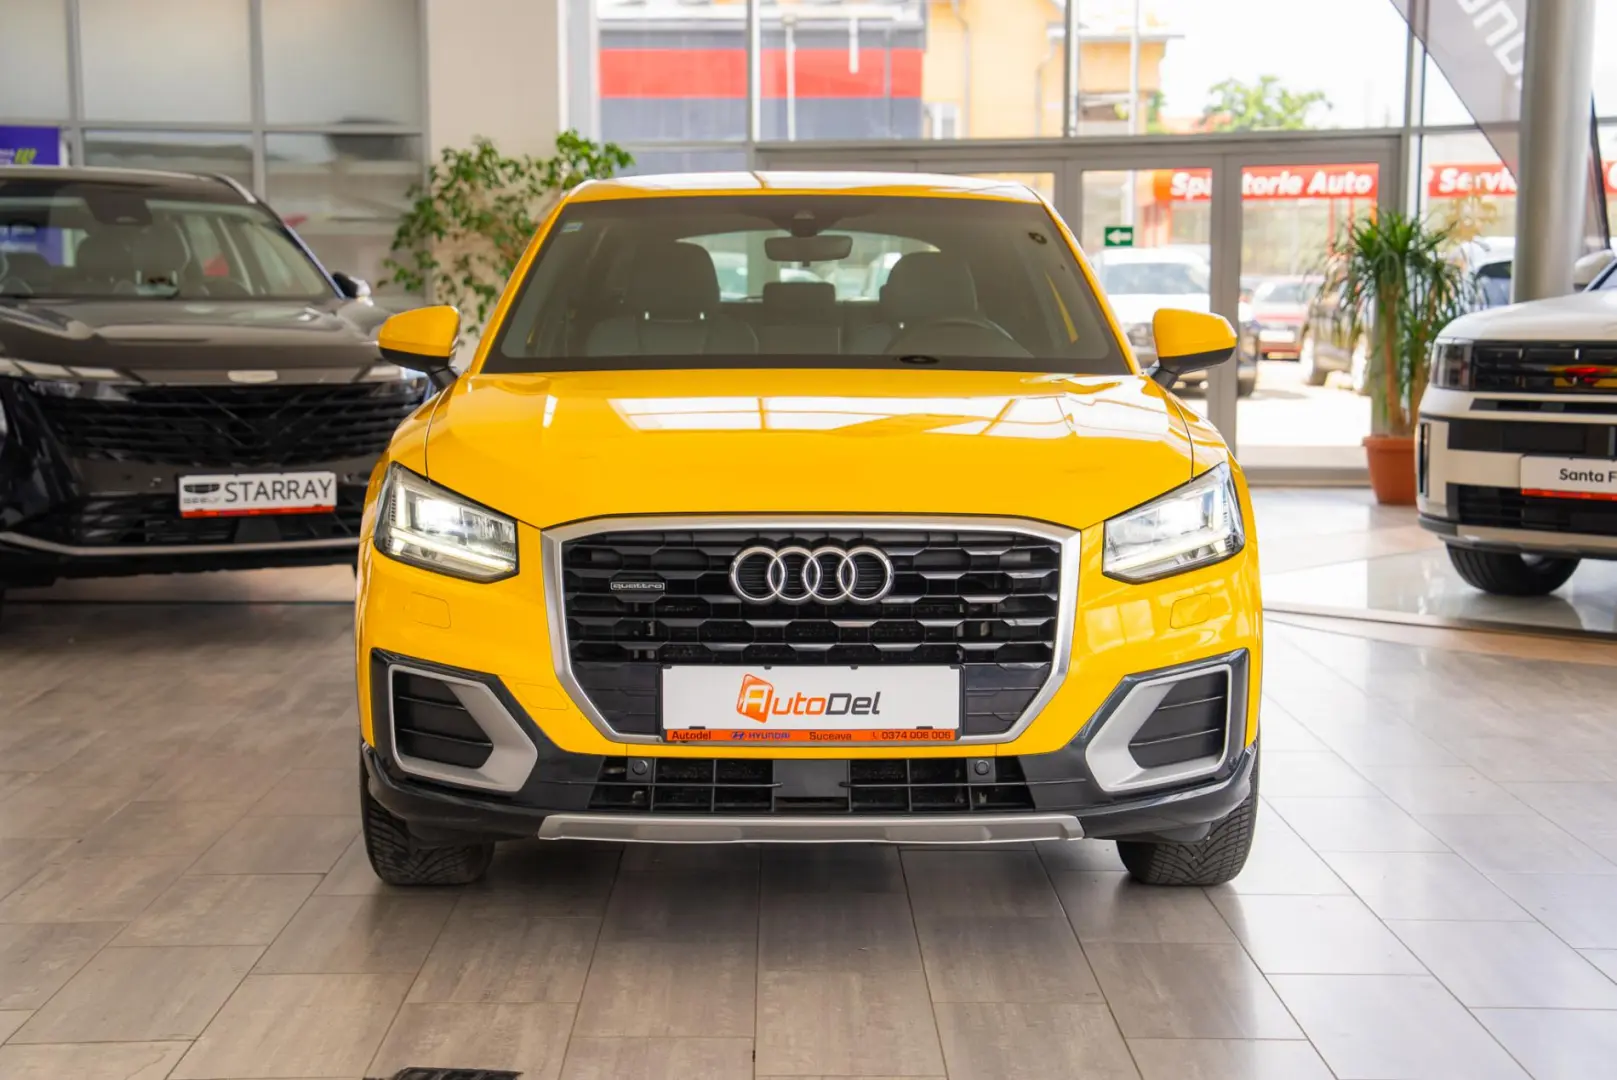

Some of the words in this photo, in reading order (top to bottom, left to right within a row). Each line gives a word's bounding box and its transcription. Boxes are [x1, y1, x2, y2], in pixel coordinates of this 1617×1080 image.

[1306, 170, 1373, 195] Auto
[1559, 468, 1604, 483] Santa
[224, 479, 333, 503] STARRAY
[739, 682, 881, 716] AutoDel
[672, 731, 711, 740] Autodel
[809, 731, 852, 741] Suceava
[881, 731, 907, 740] 0374
[909, 731, 929, 739] 006
[931, 731, 951, 739] 006
